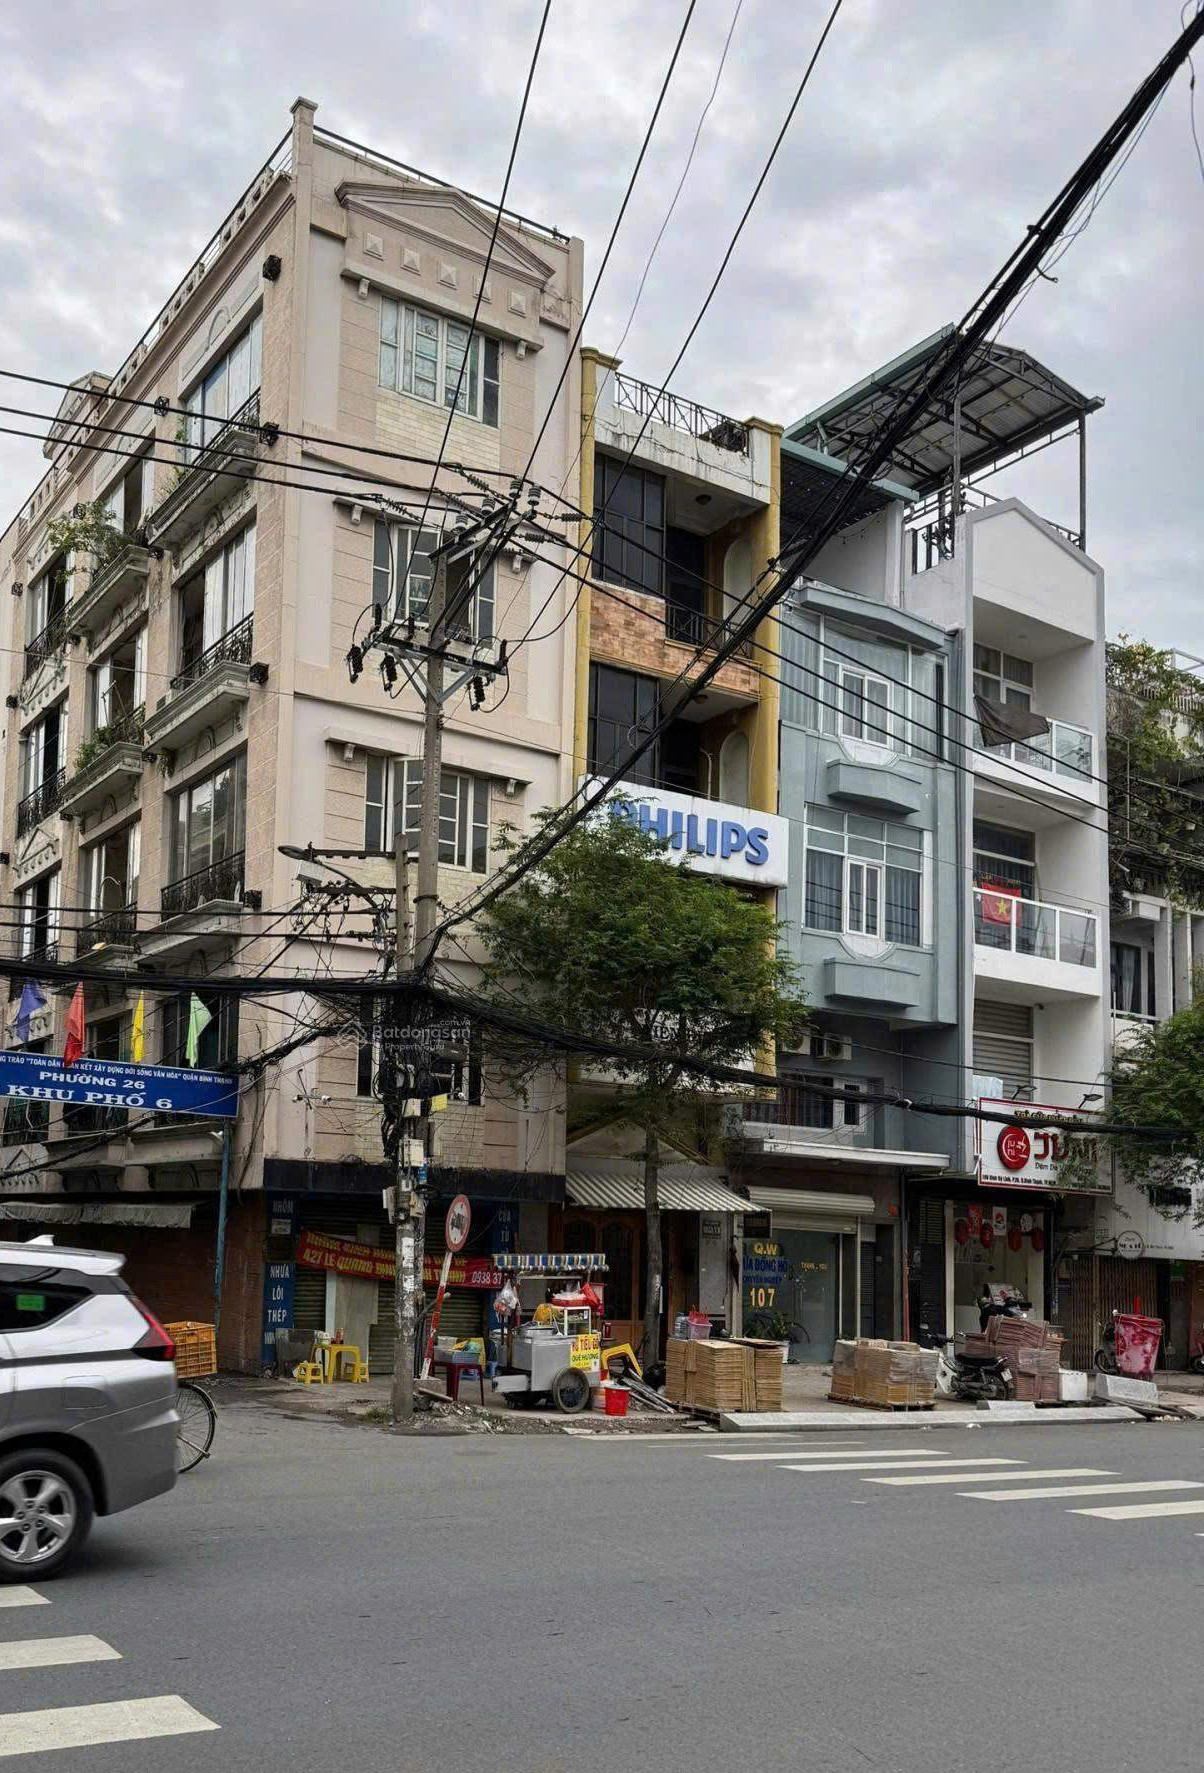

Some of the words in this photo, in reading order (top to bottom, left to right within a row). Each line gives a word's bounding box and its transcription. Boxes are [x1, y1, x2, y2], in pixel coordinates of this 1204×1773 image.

[7, 1055, 25, 1064] TRÀO
[93, 1062, 105, 1072] XÂY
[39, 1070, 117, 1088] PHƯỜNG
[122, 1079, 146, 1090] 26
[6, 1084, 75, 1101] KHU
[84, 1091, 147, 1107] PHỐ
[155, 1098, 173, 1110] 6
[471, 1270, 491, 1285] 0938
[750, 1287, 775, 1307] 107
[267, 1307, 287, 1323] THÉP
